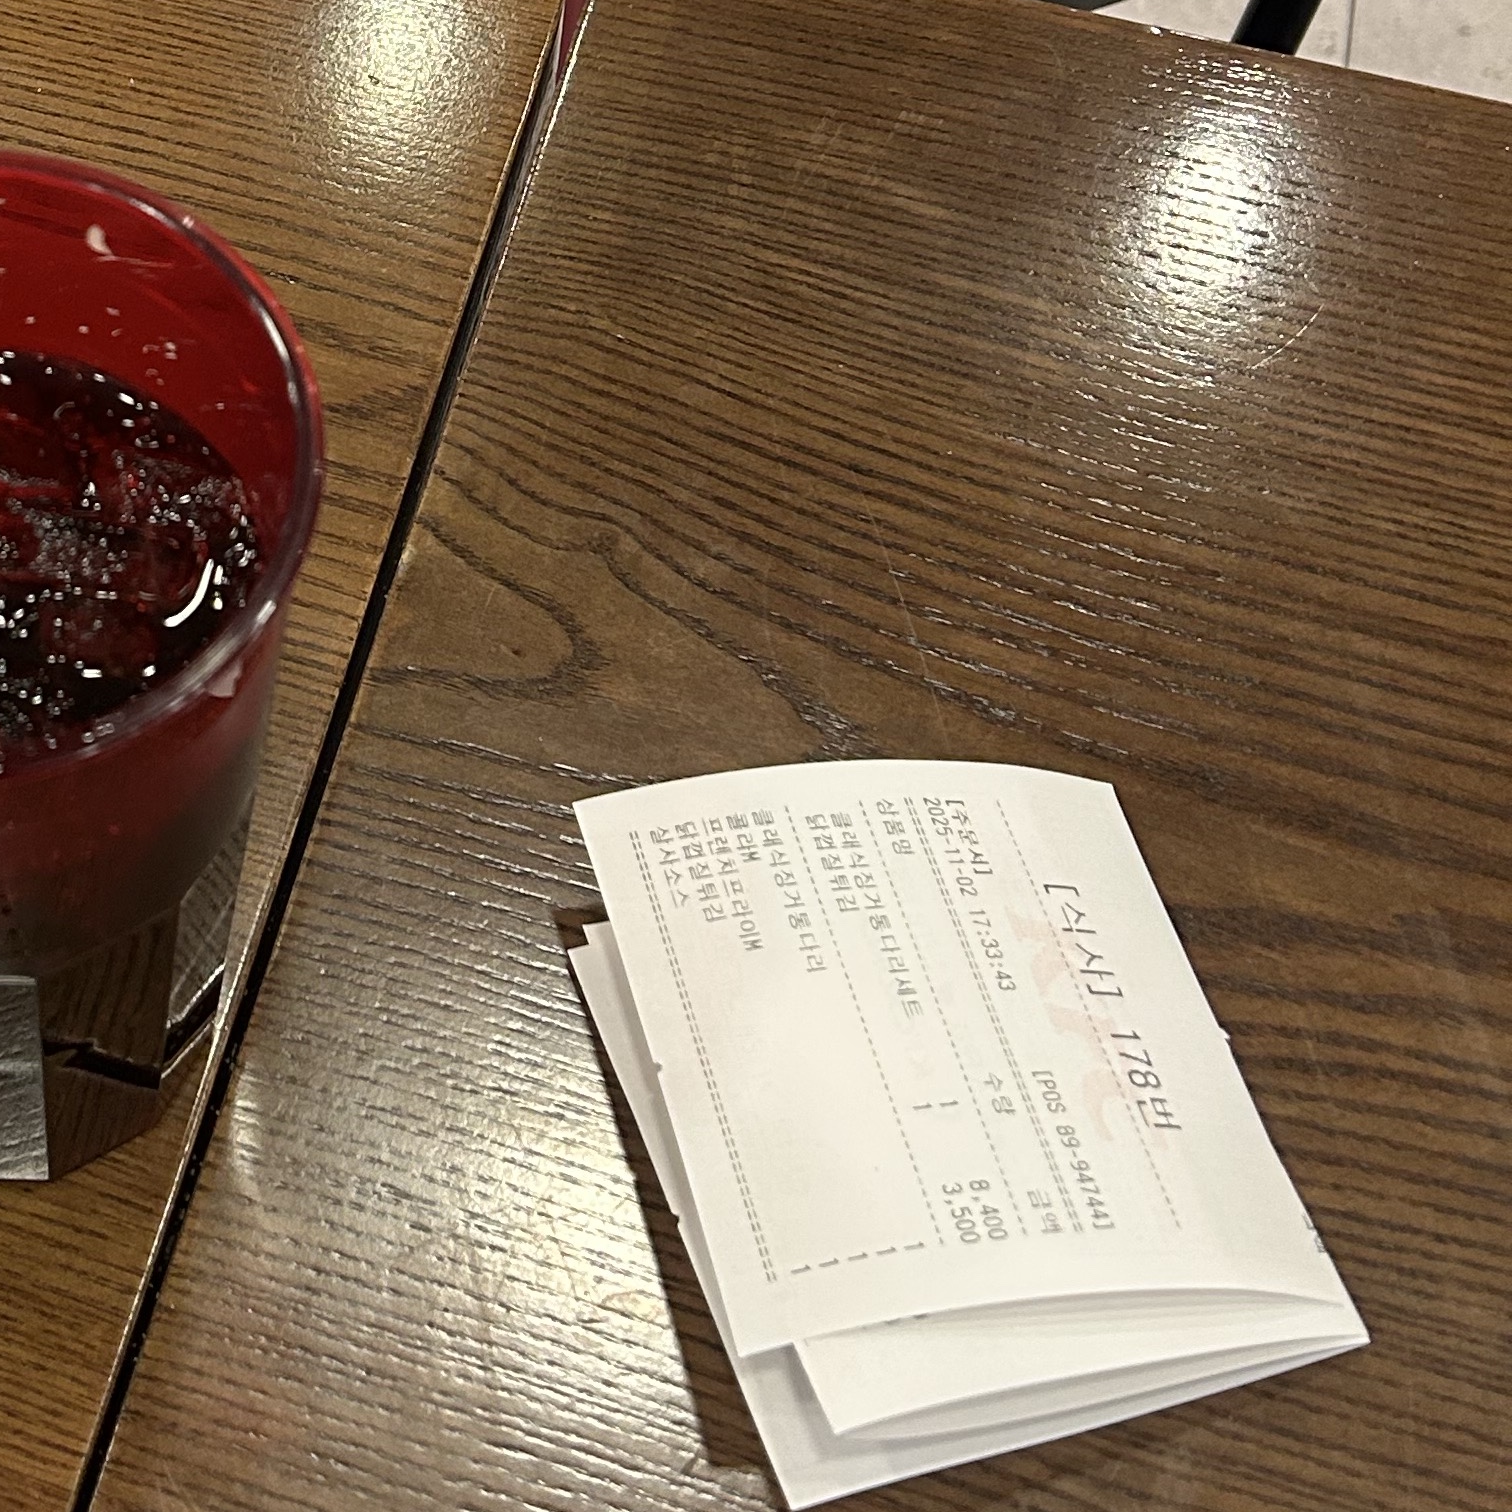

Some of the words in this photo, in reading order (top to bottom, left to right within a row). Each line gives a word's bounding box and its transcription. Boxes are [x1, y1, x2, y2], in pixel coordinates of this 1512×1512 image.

[649, 826, 689, 909] 살사소스
[790, 1264, 812, 1275] 1
[674, 820, 728, 923] 닭껍질튀김
[818, 1257, 840, 1268] 1
[701, 817, 764, 952] 프렌치프라이M
[847, 1252, 869, 1262] 1
[725, 812, 762, 863] 콜라M
[875, 1246, 897, 1256] 1
[751, 809, 828, 973] 클래식징거통다리
[903, 1240, 925, 1251] 1
[804, 813, 861, 913] 닭껍질튀김
[912, 1102, 933, 1111] 1
[941, 1182, 982, 1244] 3,500
[829, 811, 924, 1019] 클래식징거통다리세트
[938, 1099, 959, 1108] 1
[968, 1179, 1009, 1241] 8,400
[876, 798, 916, 856] 상품명
[983, 1072, 1017, 1115] 수량
[1026, 1188, 1064, 1234] 금액
[923, 797, 978, 897] 2025-11-02
[968, 909, 1017, 991] 17:33:43
[945, 798, 994, 875] [주문서]
[1042, 883, 1124, 999] [식사]
[1110, 1029, 1183, 1131] 178번
[1031, 1069, 1067, 1114] [POS
[1055, 1124, 1116, 1230] 89-94744]
